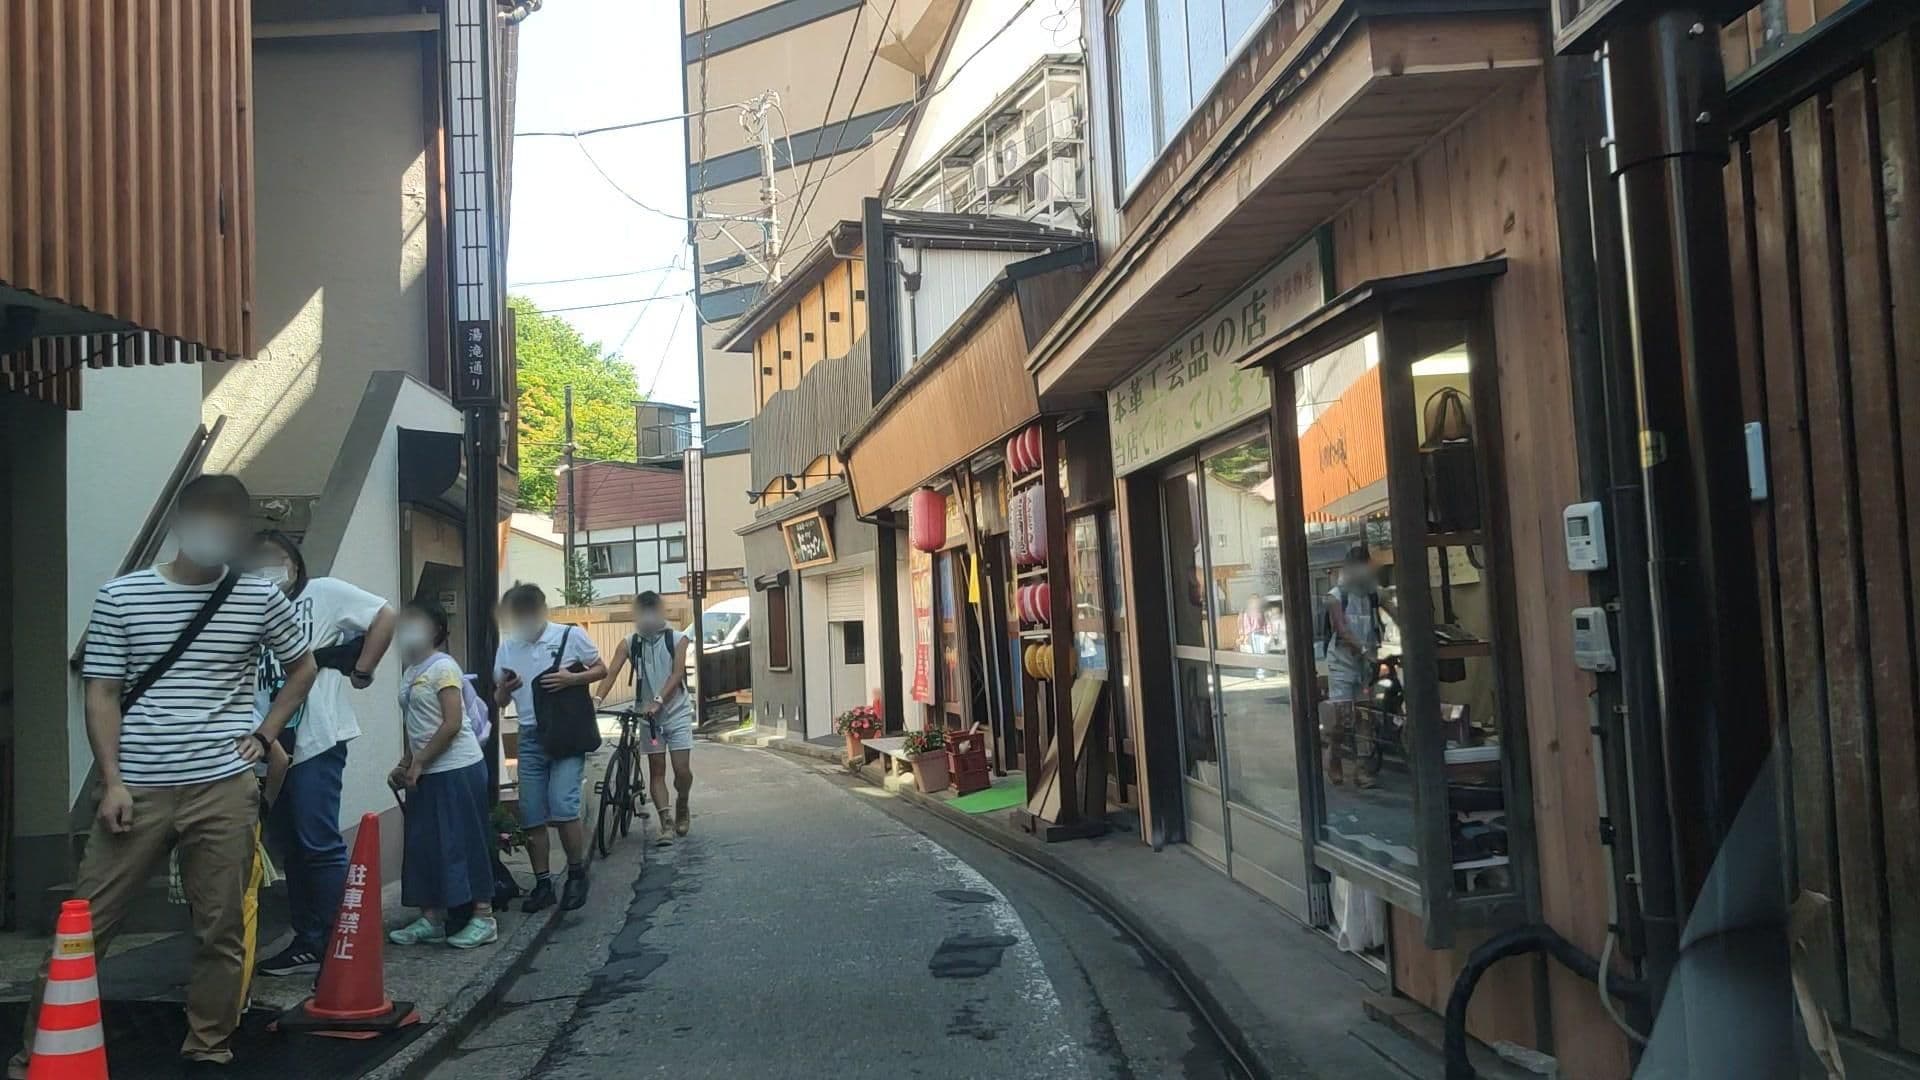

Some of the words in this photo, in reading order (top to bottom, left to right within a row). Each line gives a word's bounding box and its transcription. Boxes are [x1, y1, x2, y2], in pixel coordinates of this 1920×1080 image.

[468, 327, 484, 391] 湯滝通り
[1112, 289, 1267, 425] 本革工芸品の店
[333, 864, 368, 960] 駐車禁止
